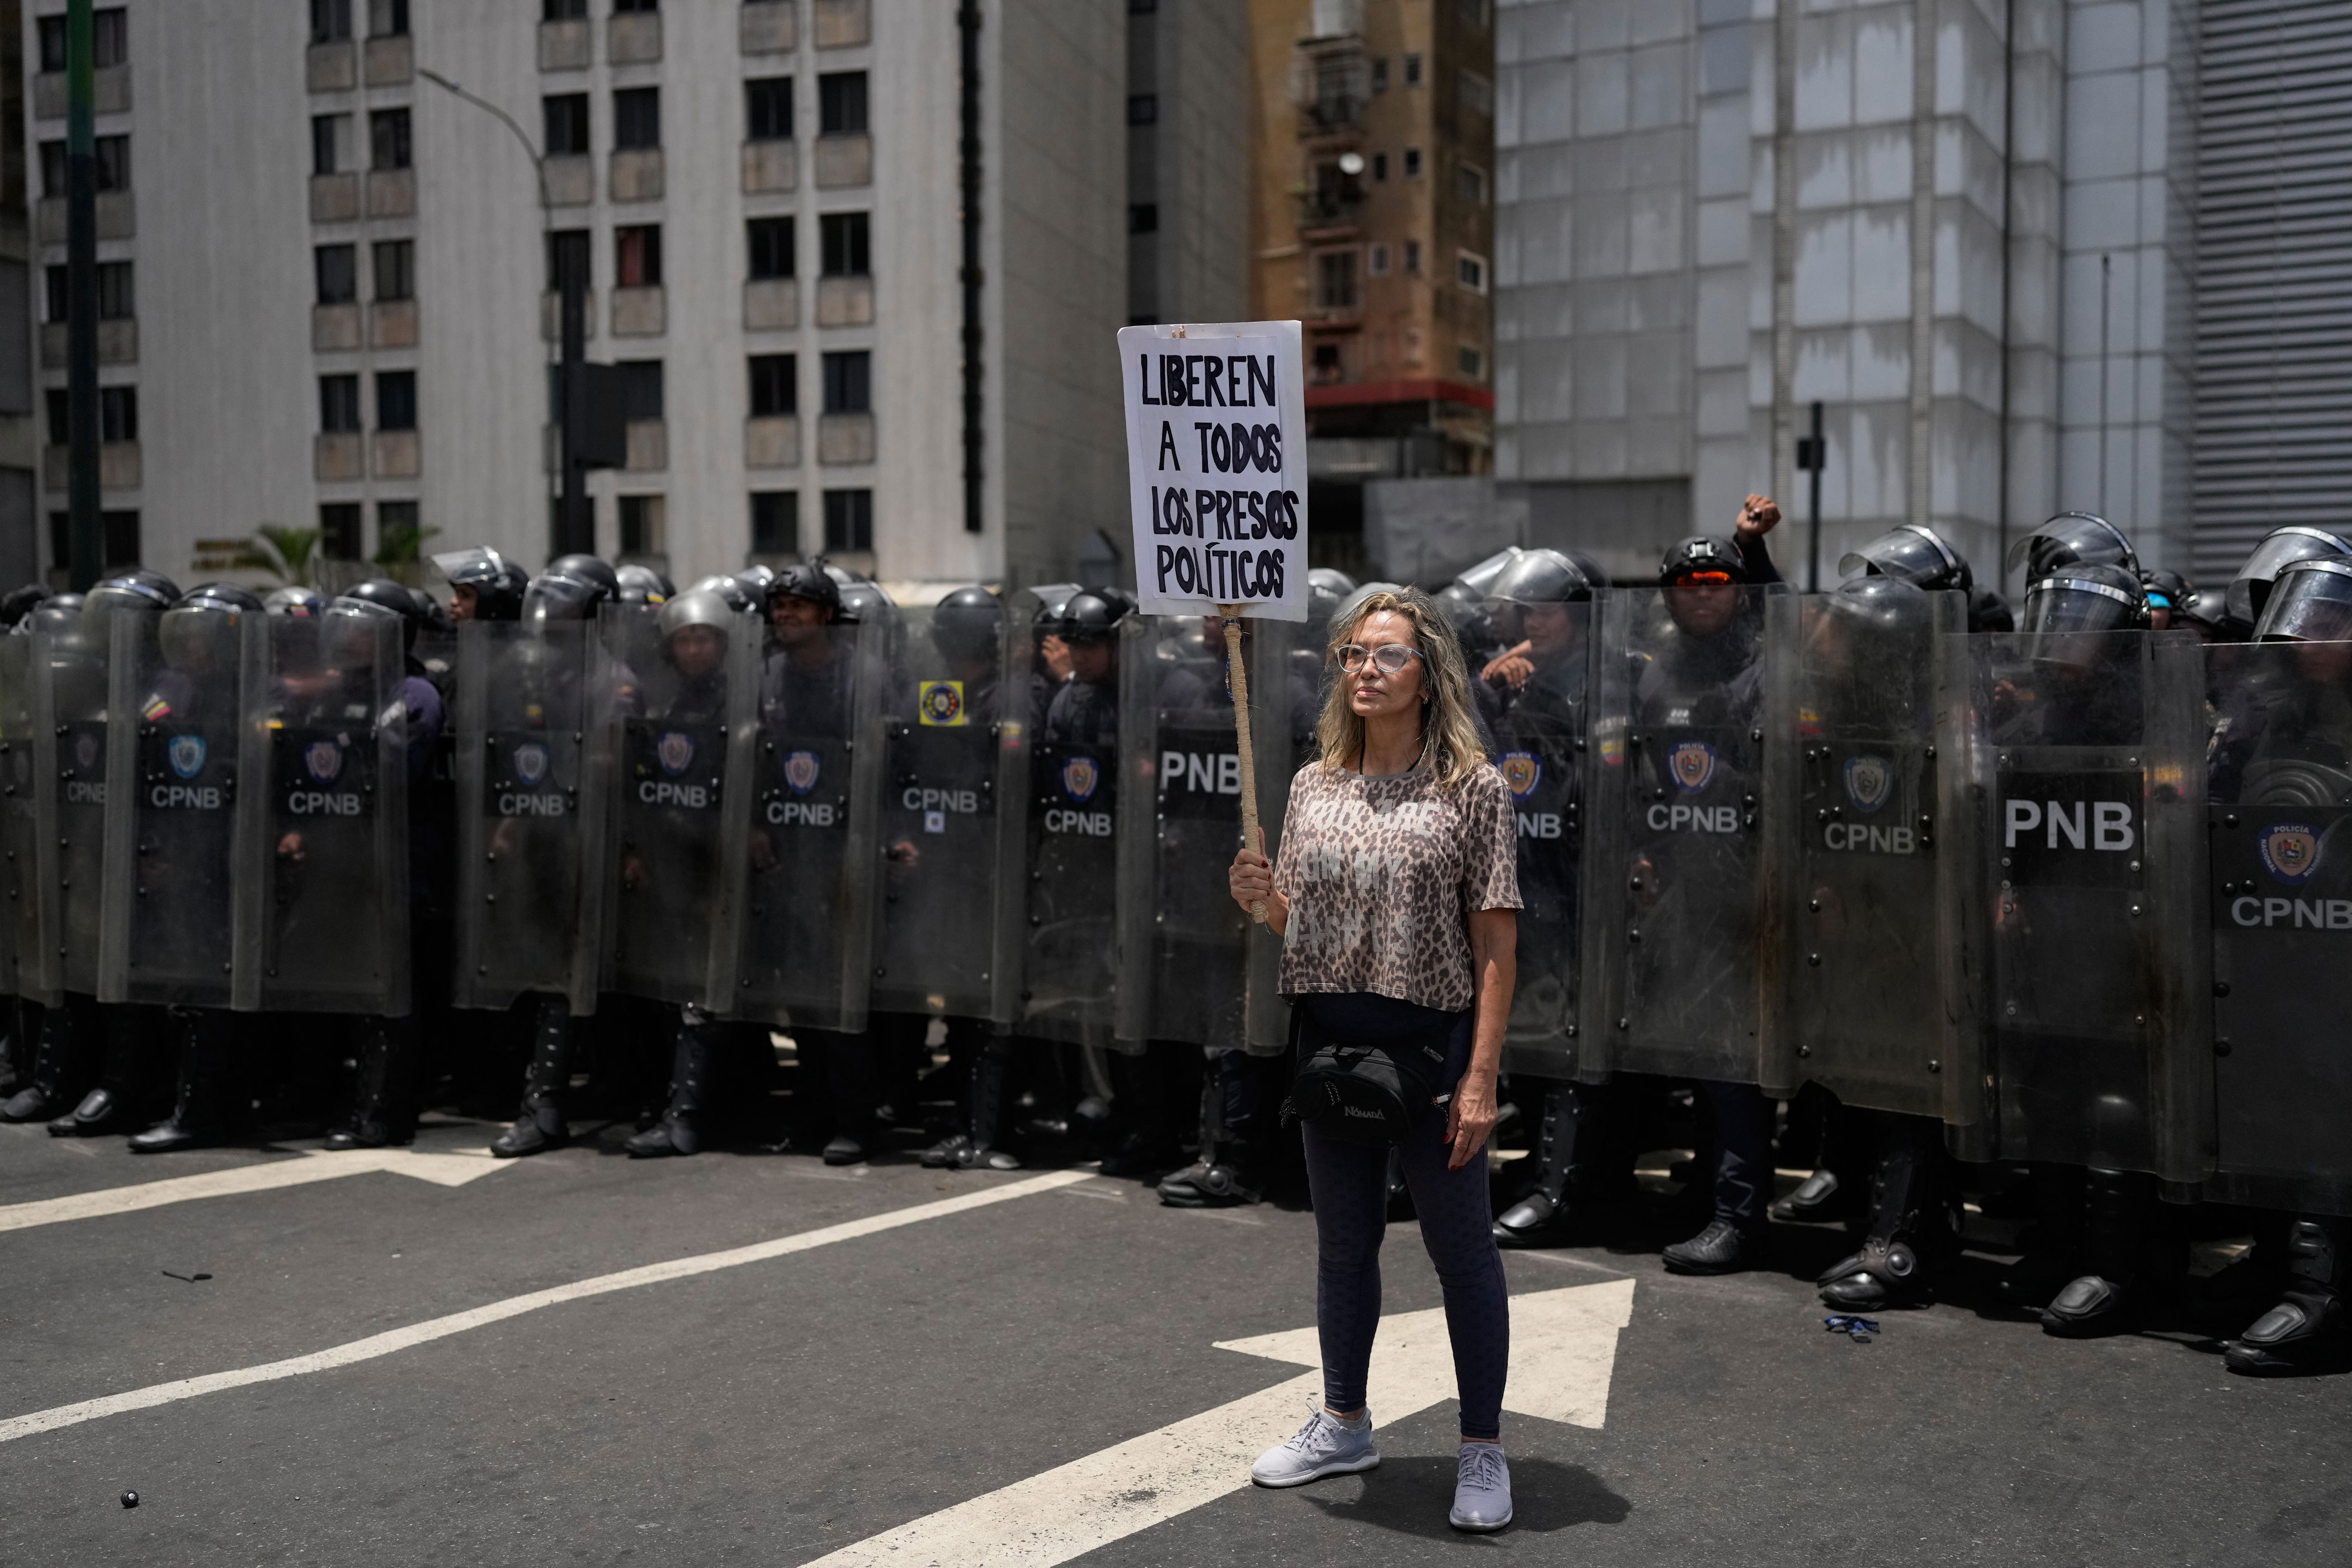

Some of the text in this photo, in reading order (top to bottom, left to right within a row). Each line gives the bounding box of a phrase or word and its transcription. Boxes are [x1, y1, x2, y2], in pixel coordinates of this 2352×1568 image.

[1140, 353, 1276, 407] LIBEREN
[1159, 421, 1282, 474] A TODOS
[1151, 486, 1299, 540] LOS PRESOS
[1157, 541, 1284, 599] POLÍTICOS
[1159, 750, 1241, 795] PNB
[151, 784, 220, 810] CPNB
[289, 791, 361, 816] CPNB
[499, 792, 564, 818] CPNB
[639, 780, 707, 809] CPNB
[902, 787, 978, 814] CPNB
[766, 801, 834, 827] CPNB
[1044, 809, 1112, 838] CPNB
[1369, 799, 1441, 838] ARE
[1516, 812, 1562, 839] NB
[1647, 804, 1738, 834] CPNB
[2004, 799, 2134, 852] PNB
[2273, 824, 2310, 834] POLICÍA
[1824, 822, 1915, 855] CPNB
[1301, 842, 1411, 894] ON MY
[2260, 838, 2277, 873] NACIONAL
[2230, 896, 2352, 929] CPNB
